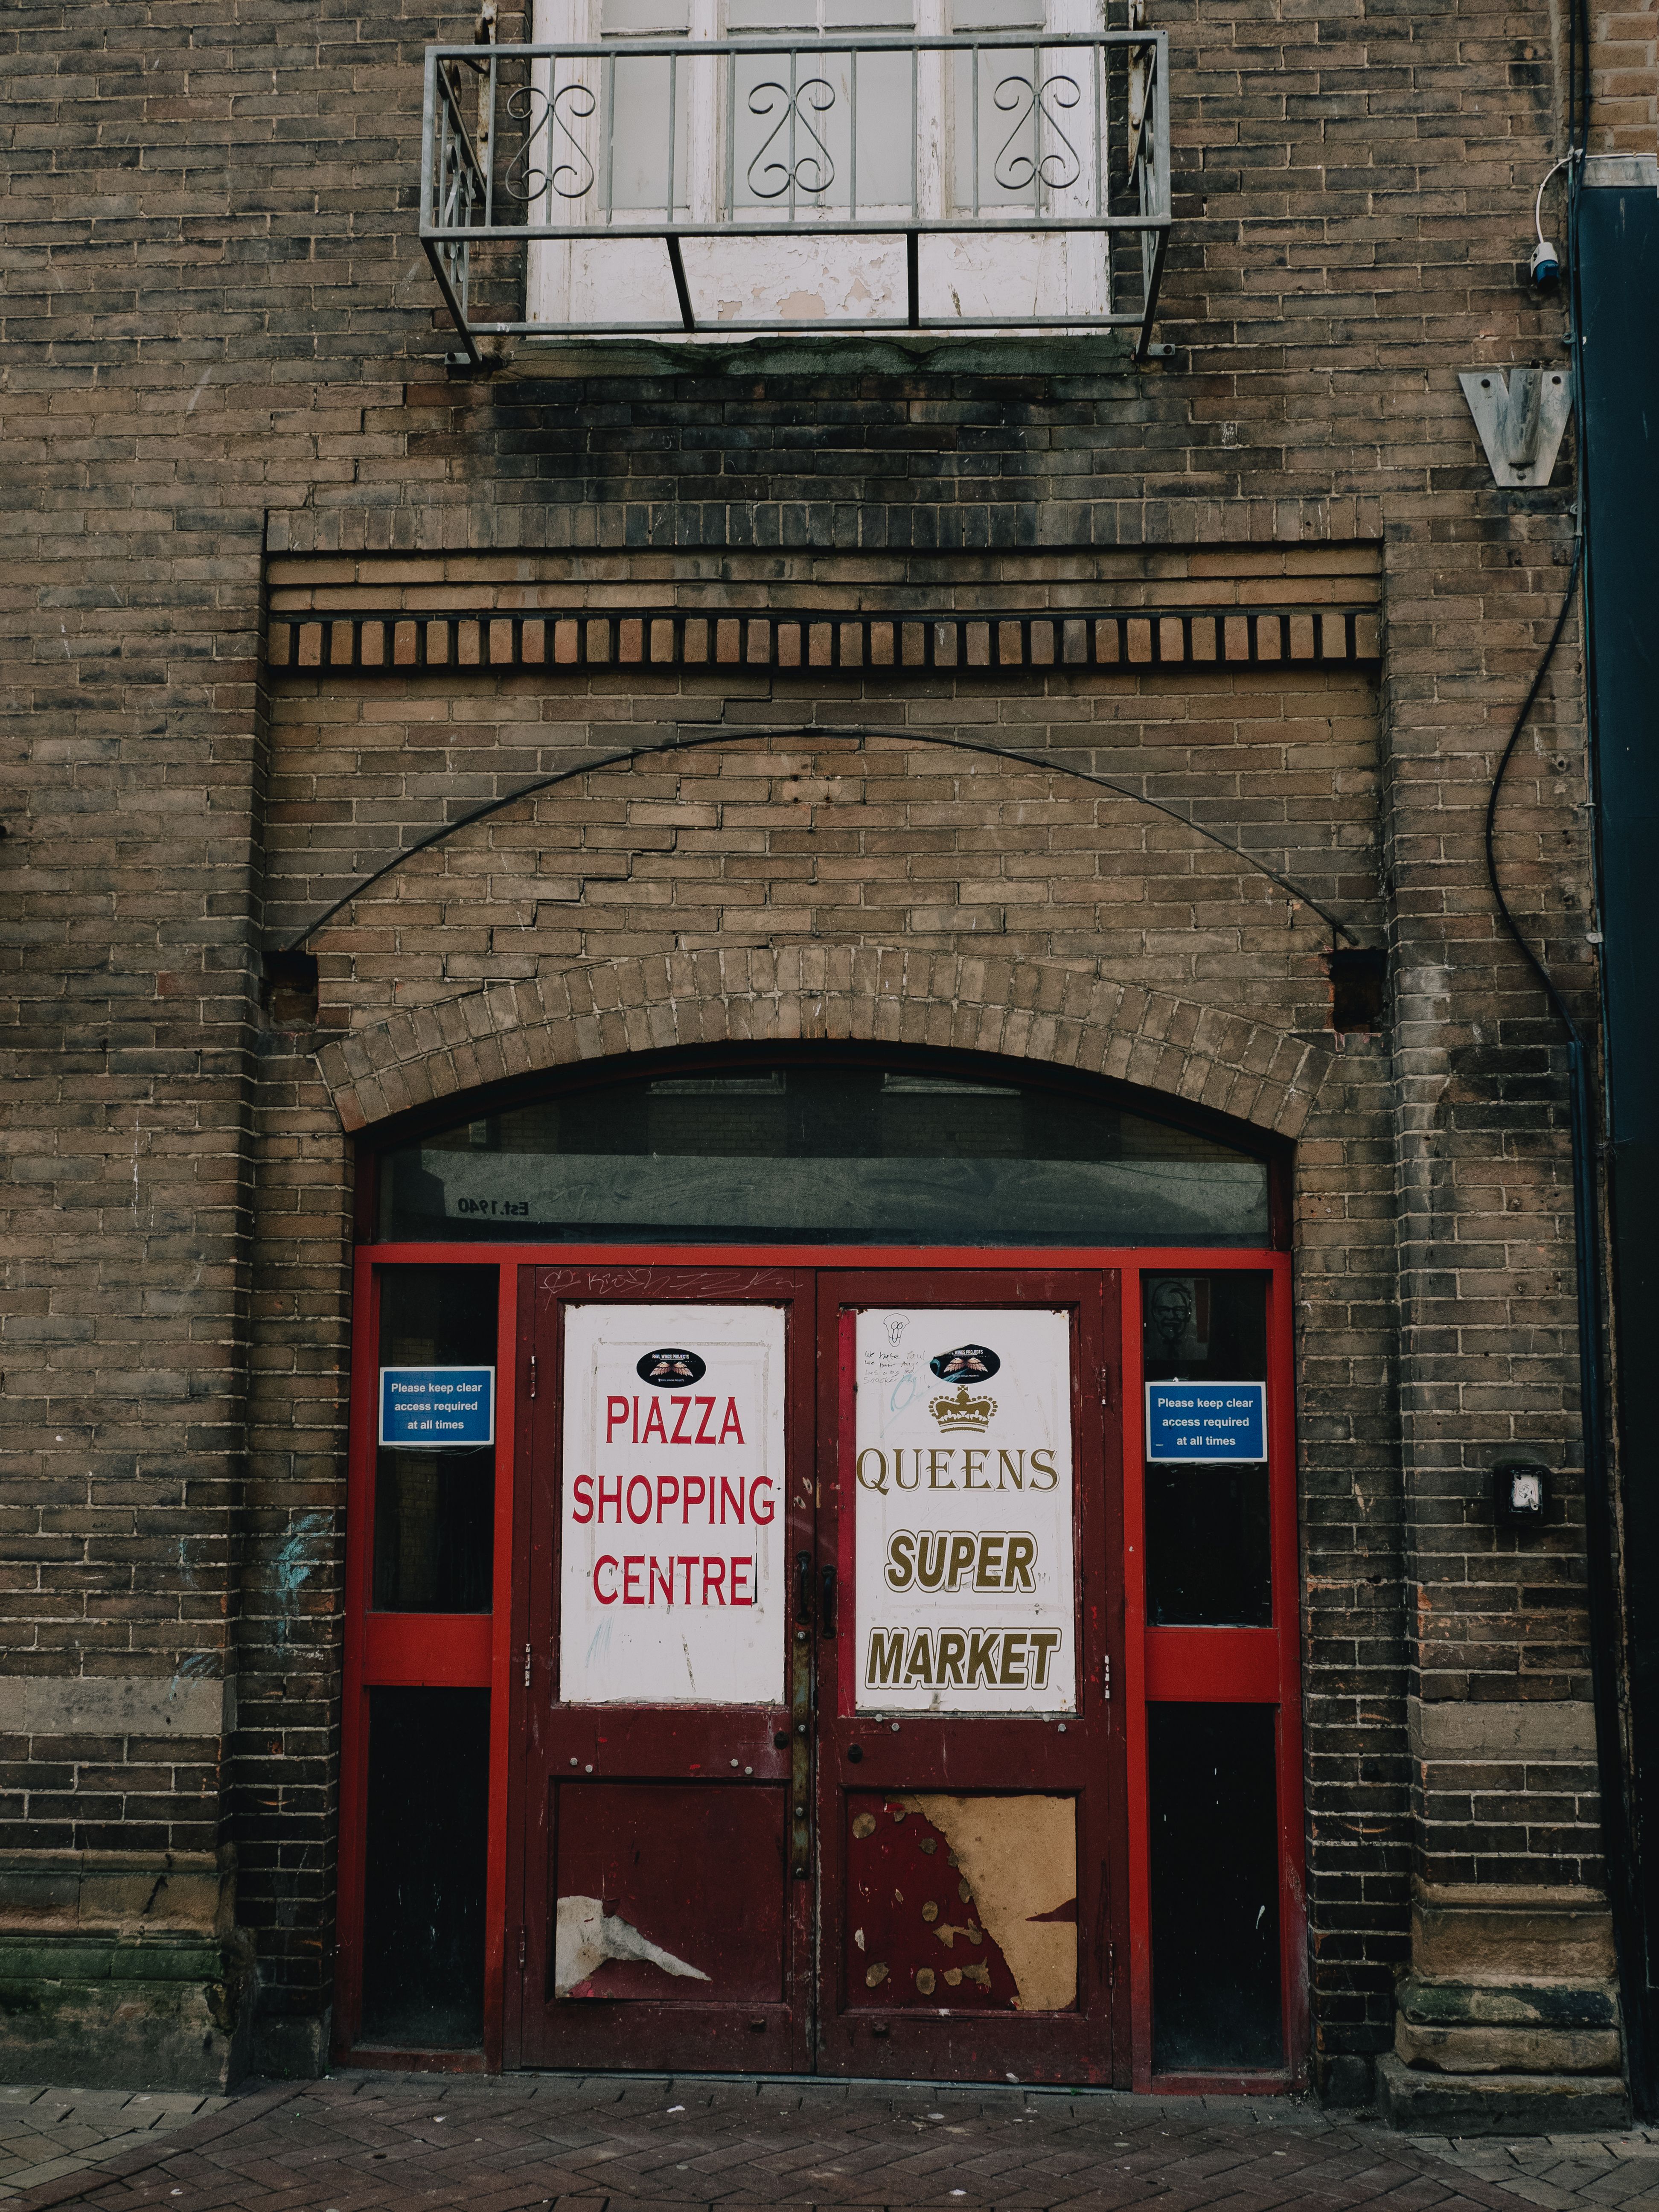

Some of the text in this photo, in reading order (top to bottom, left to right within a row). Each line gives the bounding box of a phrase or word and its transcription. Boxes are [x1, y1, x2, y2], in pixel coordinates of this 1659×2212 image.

[391, 1383, 483, 1394] Please keep clear
[434, 1401, 478, 1412] required
[1158, 1398, 1253, 1409] Please keep clear
[407, 1420, 464, 1429] at all times
[606, 1396, 744, 1444] PIAZZA
[1204, 1417, 1249, 1429] required
[1176, 1436, 1236, 1446] at all times
[856, 1448, 1059, 1495] QUEENS
[573, 1475, 775, 1525] SHOPPING
[885, 1529, 1037, 1592] SUPER
[594, 1555, 753, 1606] CENTRE
[865, 1627, 1061, 1690] MARKET
